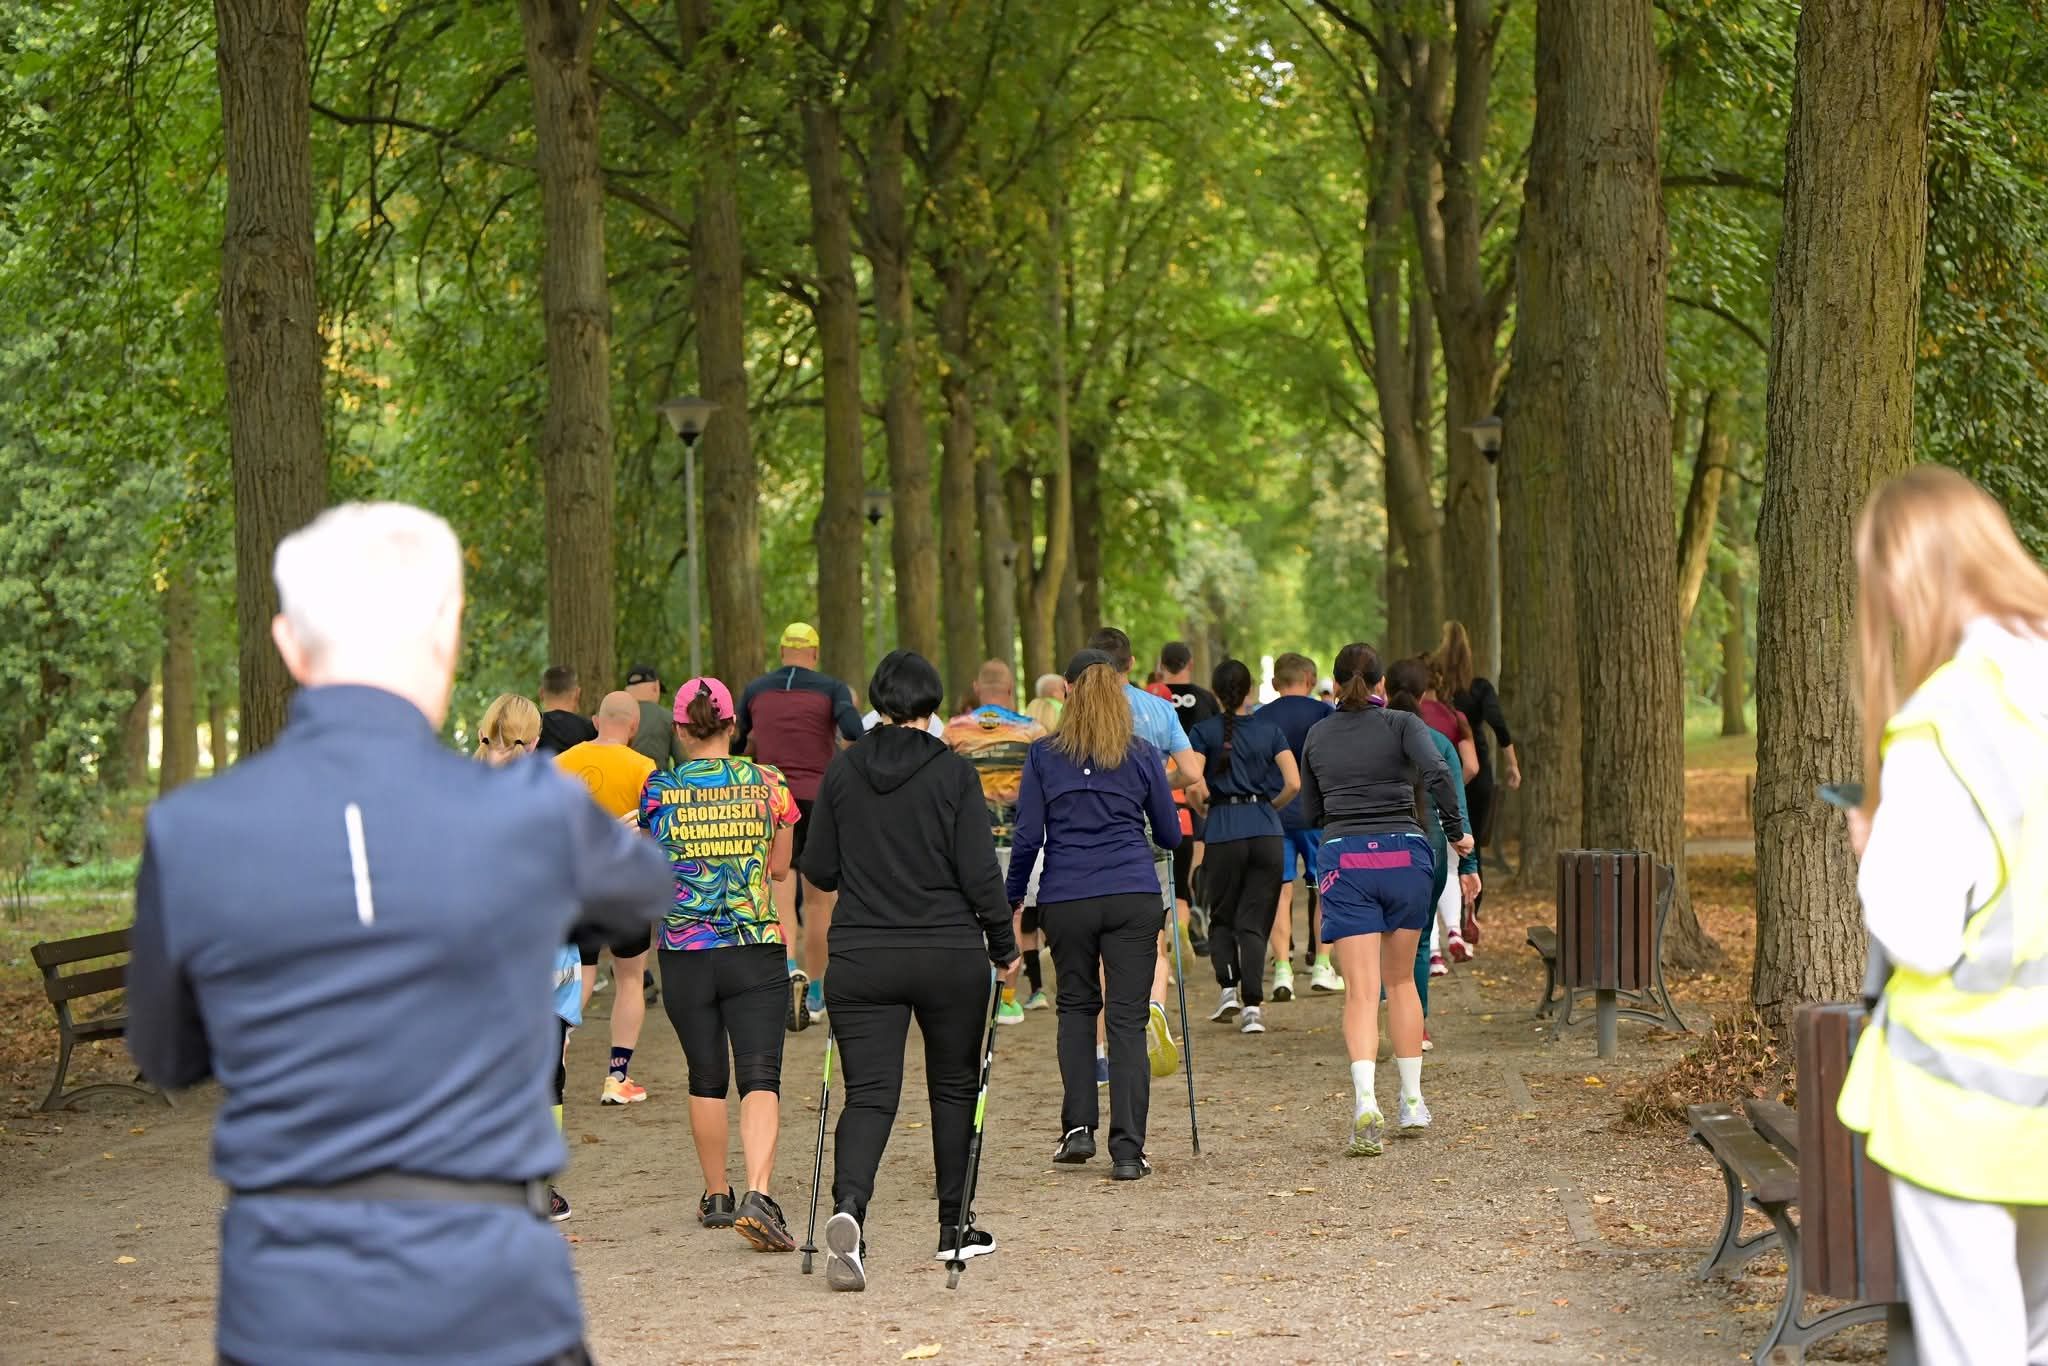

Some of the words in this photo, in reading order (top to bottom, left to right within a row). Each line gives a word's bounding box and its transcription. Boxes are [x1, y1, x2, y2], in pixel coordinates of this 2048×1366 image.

[662, 789, 691, 804] XVII
[697, 785, 769, 801] HUNTERS
[677, 804, 757, 822] GRODZISKI
[670, 822, 764, 841] PÓŁMARATON
